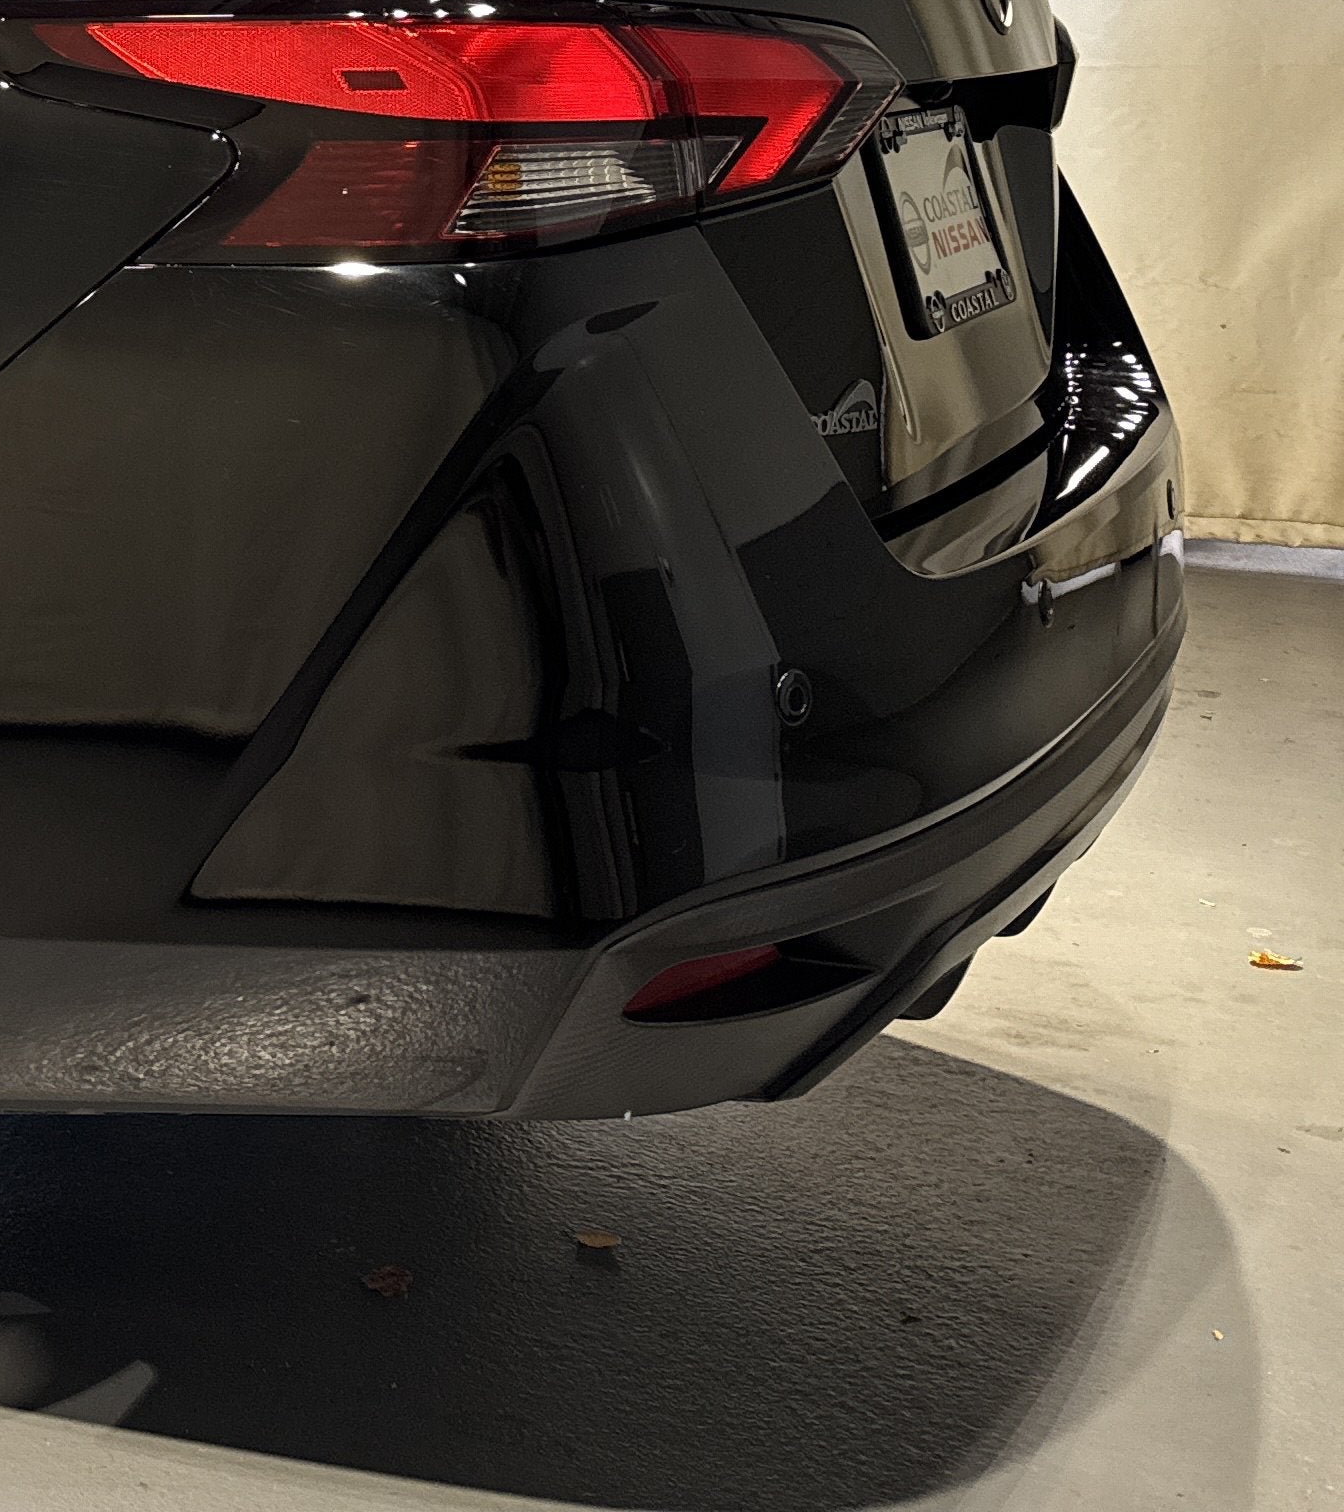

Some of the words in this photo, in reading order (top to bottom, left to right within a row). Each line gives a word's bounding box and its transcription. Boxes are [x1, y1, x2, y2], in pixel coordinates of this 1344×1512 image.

[923, 185, 978, 223] COASTAL
[931, 215, 991, 260] NISSAN
[950, 287, 999, 322] COASTAL
